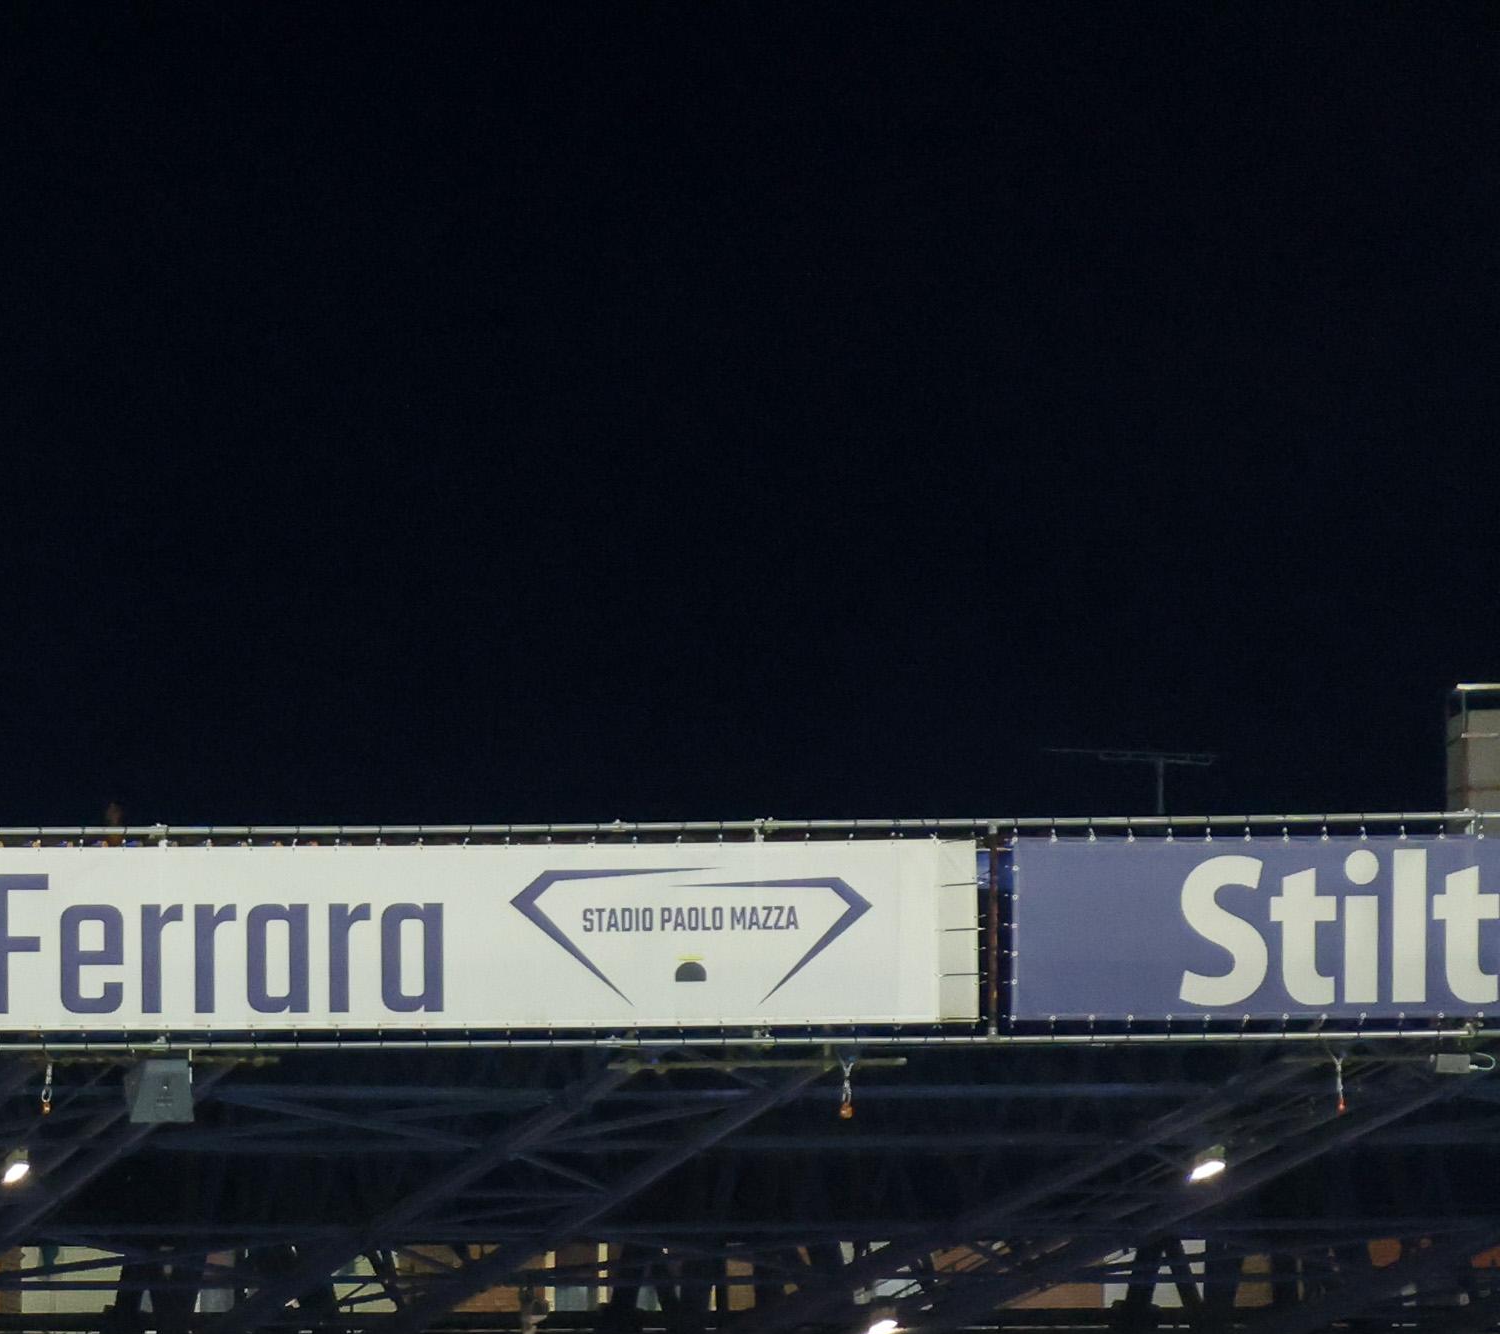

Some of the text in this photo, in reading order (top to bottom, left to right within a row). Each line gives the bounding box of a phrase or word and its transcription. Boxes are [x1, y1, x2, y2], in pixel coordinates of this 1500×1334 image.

[582, 905, 799, 932] STADIO PAOLO MAZZA
[1179, 848, 1500, 1007] Stilt
